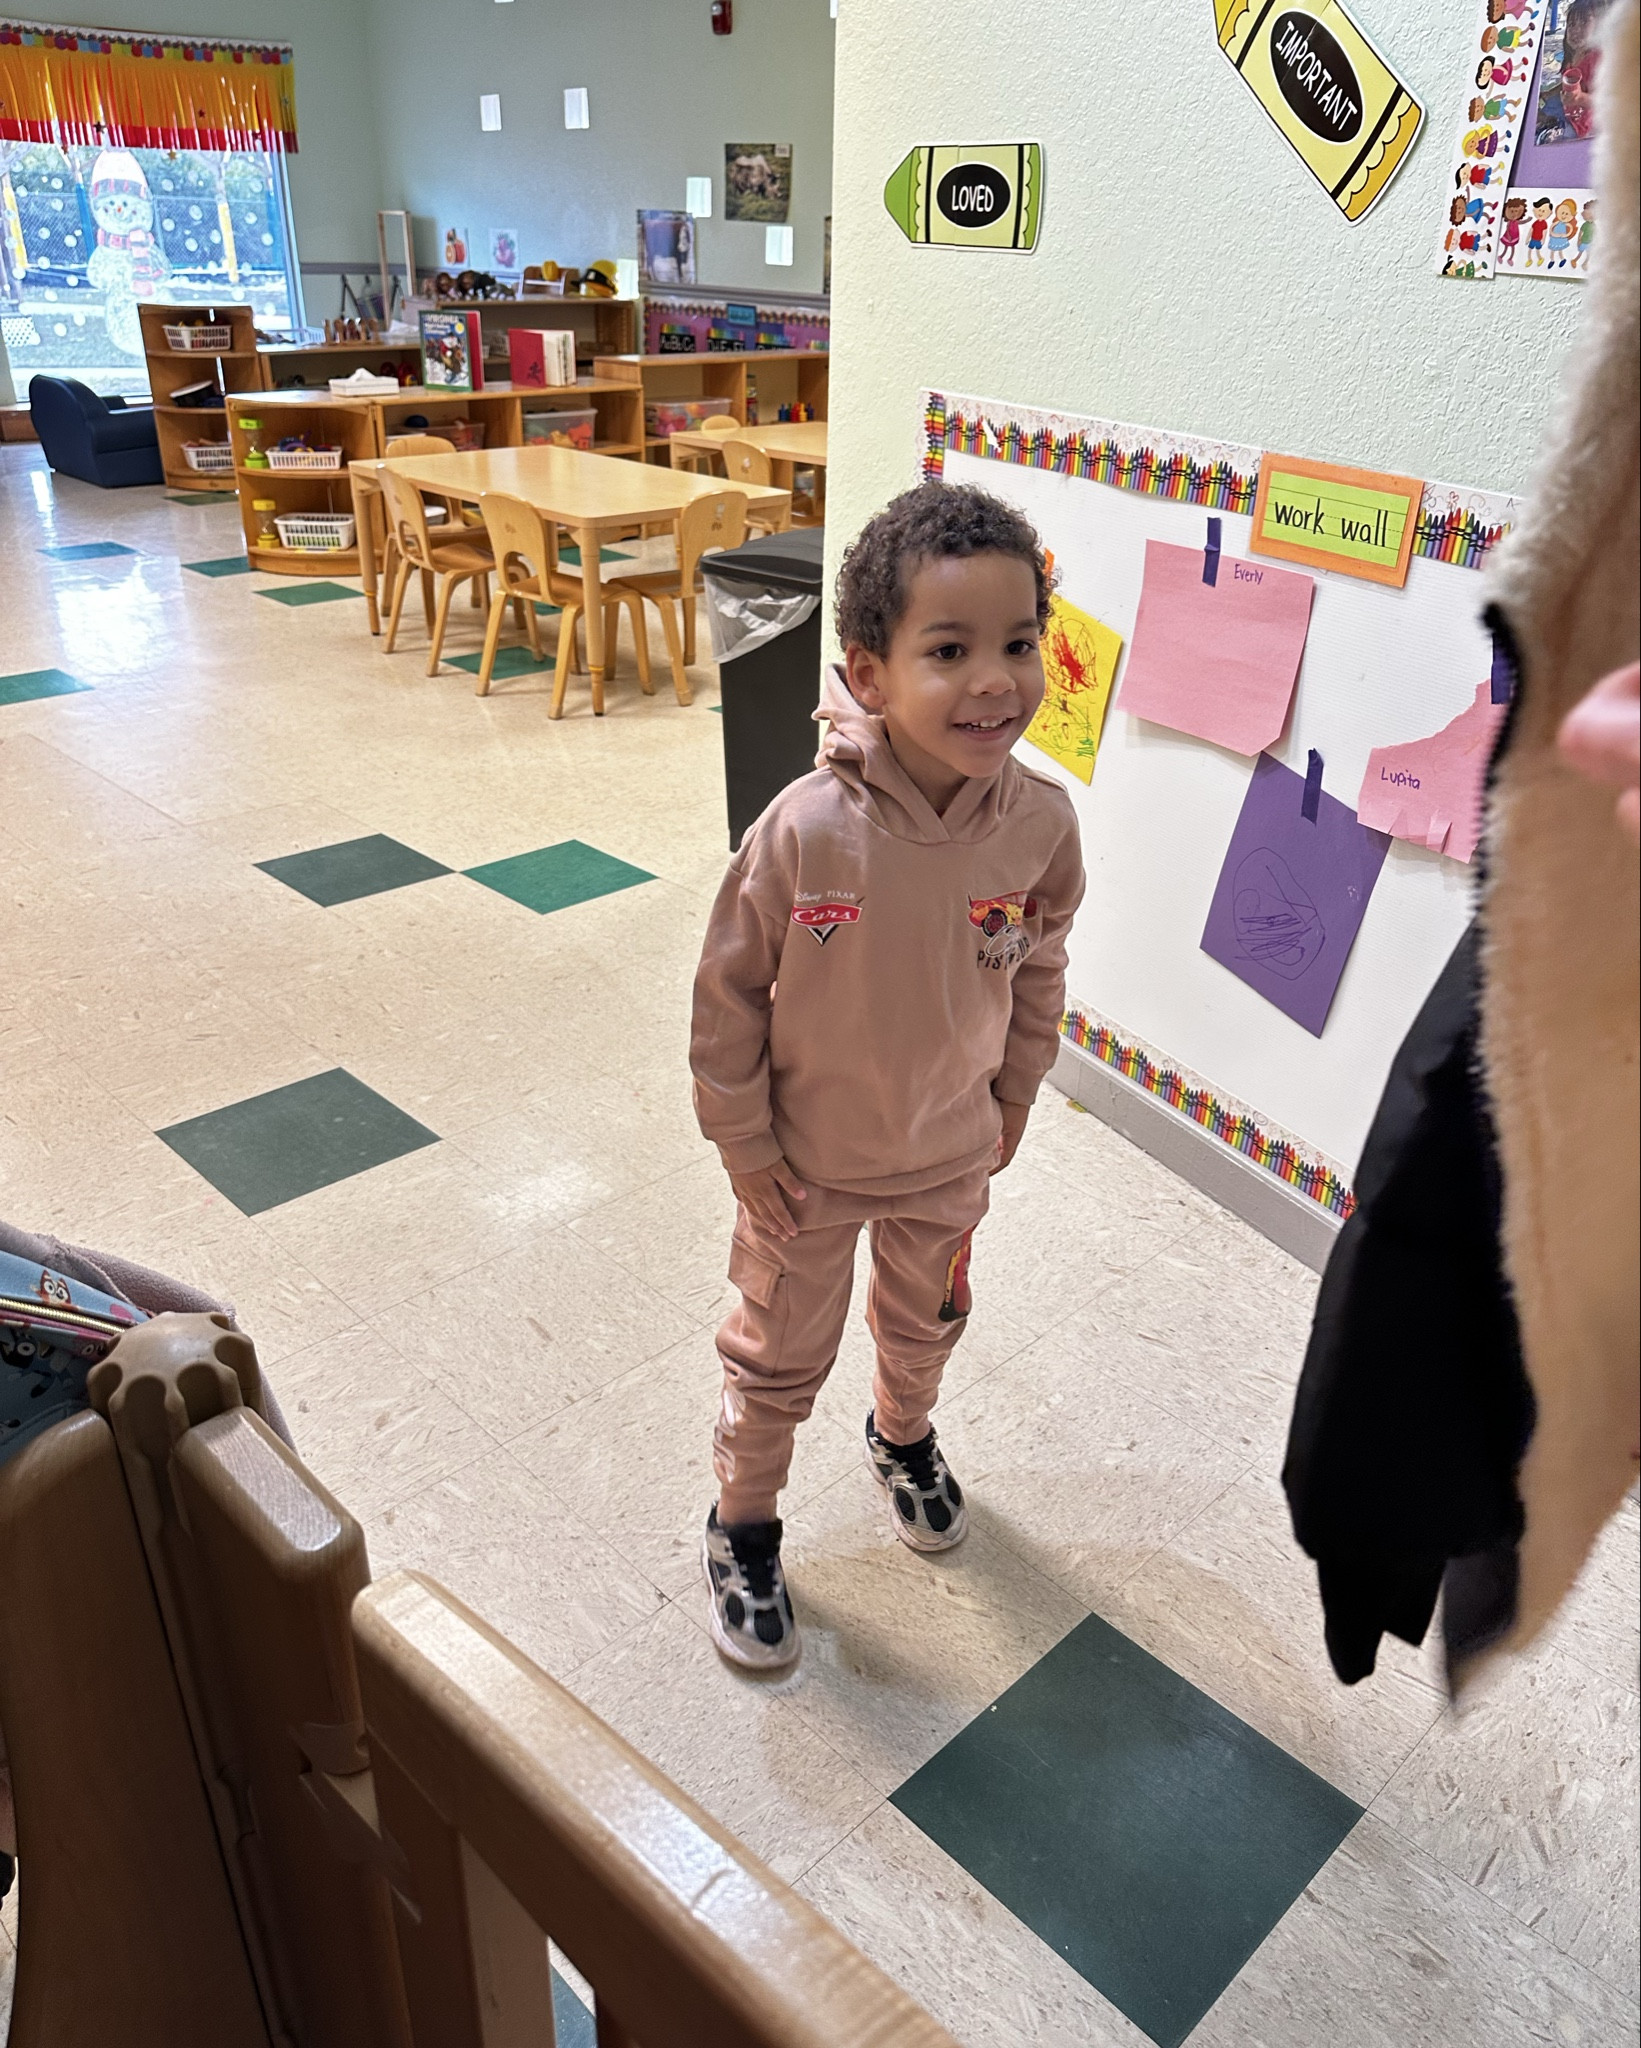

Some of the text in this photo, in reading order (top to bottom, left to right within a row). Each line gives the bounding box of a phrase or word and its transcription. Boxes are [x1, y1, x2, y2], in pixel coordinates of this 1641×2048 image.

[1275, 20, 1358, 131] IMPORTANT
[951, 184, 995, 213] LOVED
[1274, 497, 1389, 548] work wall
[1233, 562, 1264, 586] Everly
[1381, 766, 1421, 790] Lupita
[826, 890, 856, 900] PIXAR
[793, 909, 852, 923] Cars
